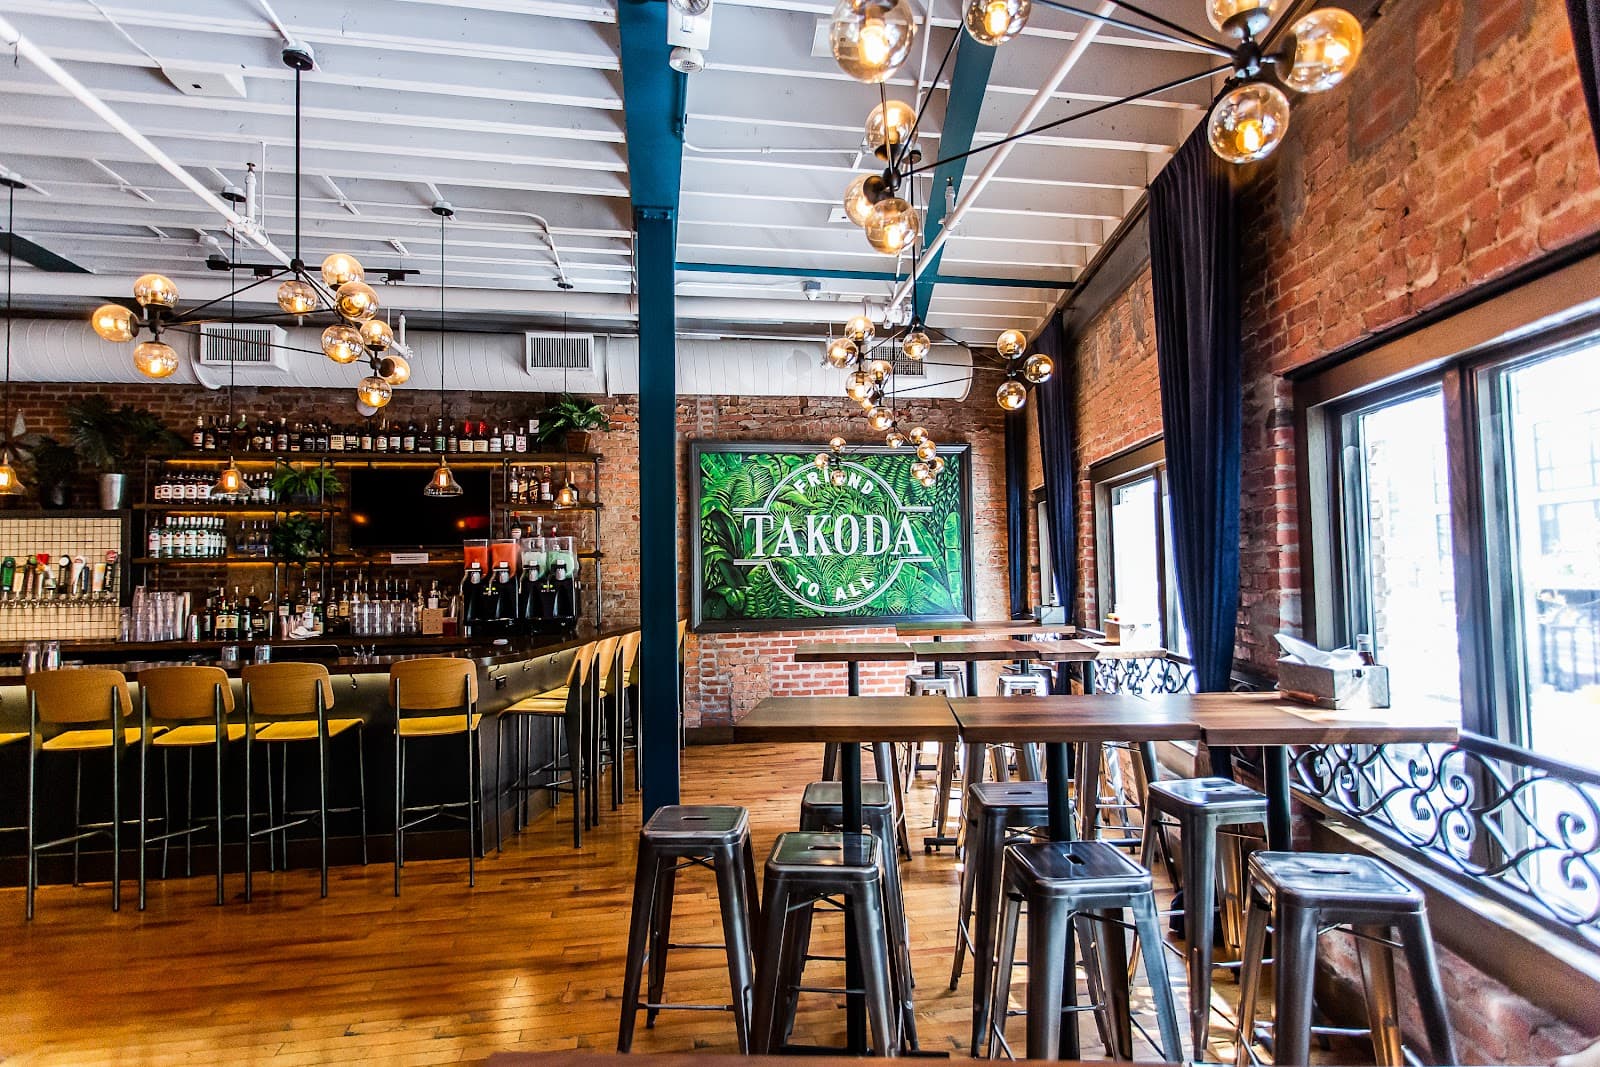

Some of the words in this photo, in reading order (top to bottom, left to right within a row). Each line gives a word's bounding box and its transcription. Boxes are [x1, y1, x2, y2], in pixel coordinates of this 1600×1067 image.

[793, 468, 873, 494] FRIND
[743, 514, 922, 557] TAKODA
[795, 574, 819, 597] TO
[835, 576, 875, 601] ALL
